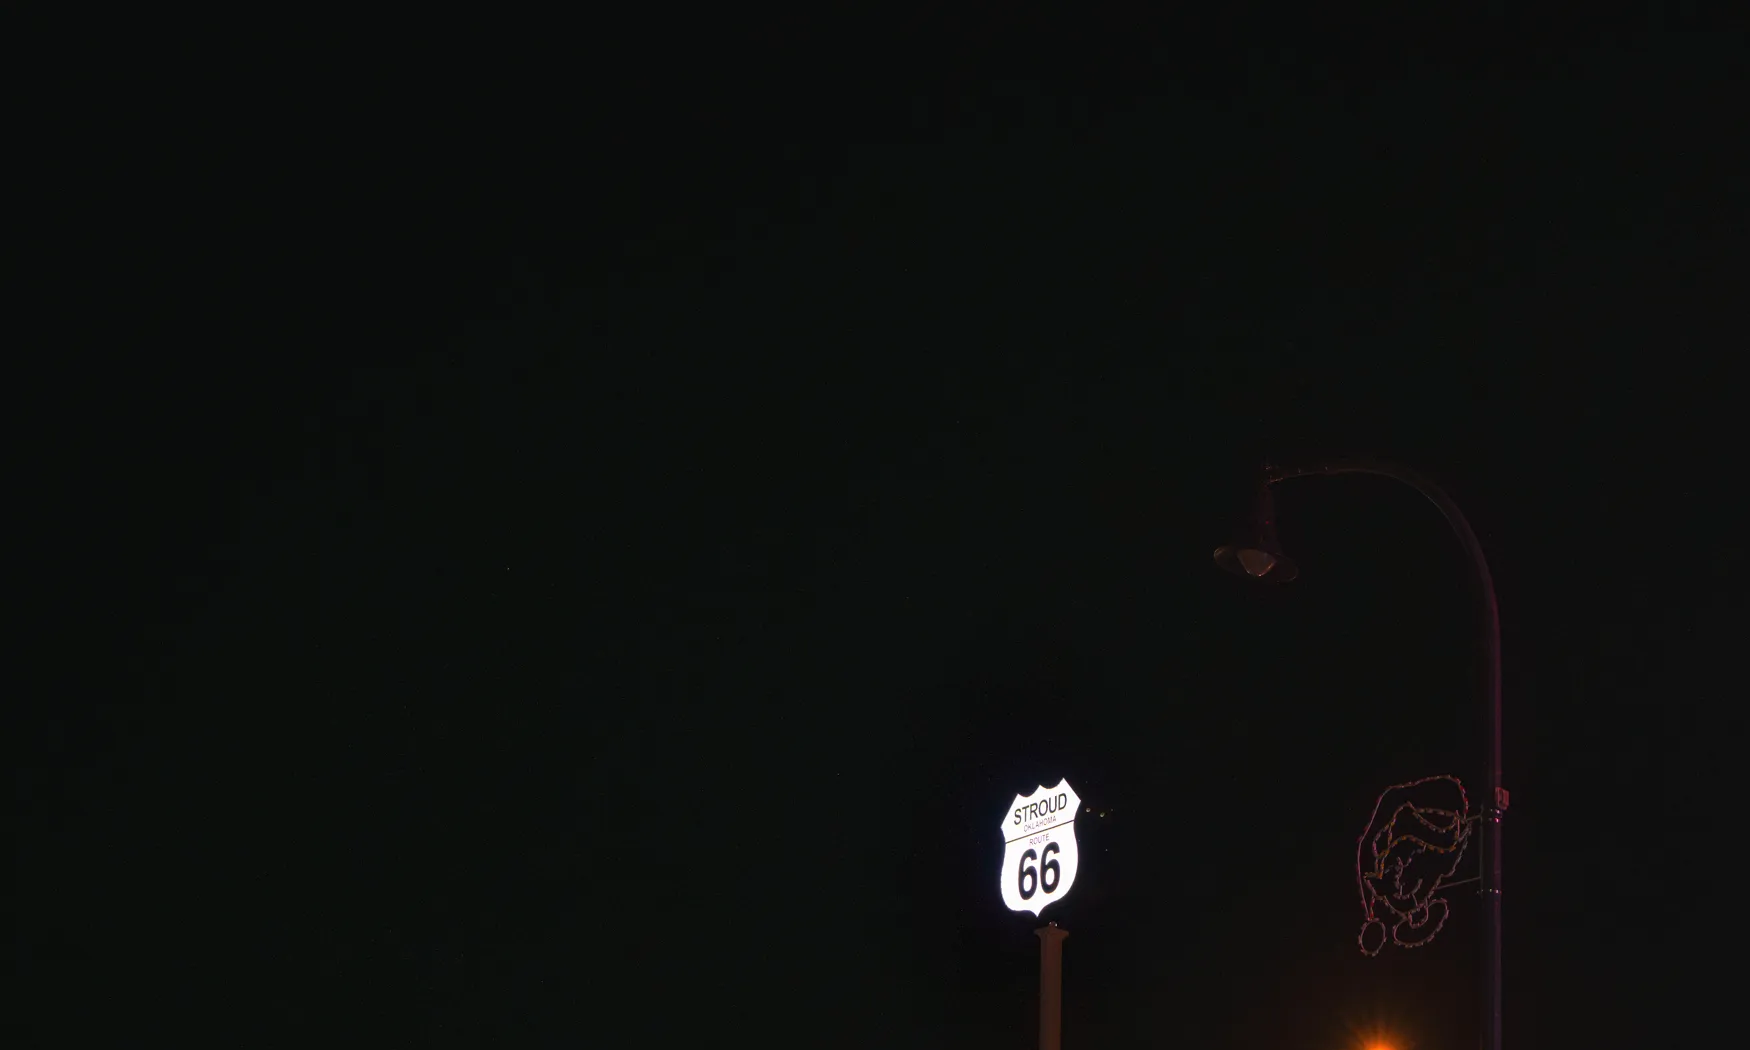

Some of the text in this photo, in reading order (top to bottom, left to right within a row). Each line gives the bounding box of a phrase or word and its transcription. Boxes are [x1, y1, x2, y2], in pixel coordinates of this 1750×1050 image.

[1013, 792, 1068, 826] STROUD
[1023, 815, 1057, 833] OKLAHOMA
[1028, 833, 1050, 846] ROUTE
[1017, 841, 1061, 901] 66
